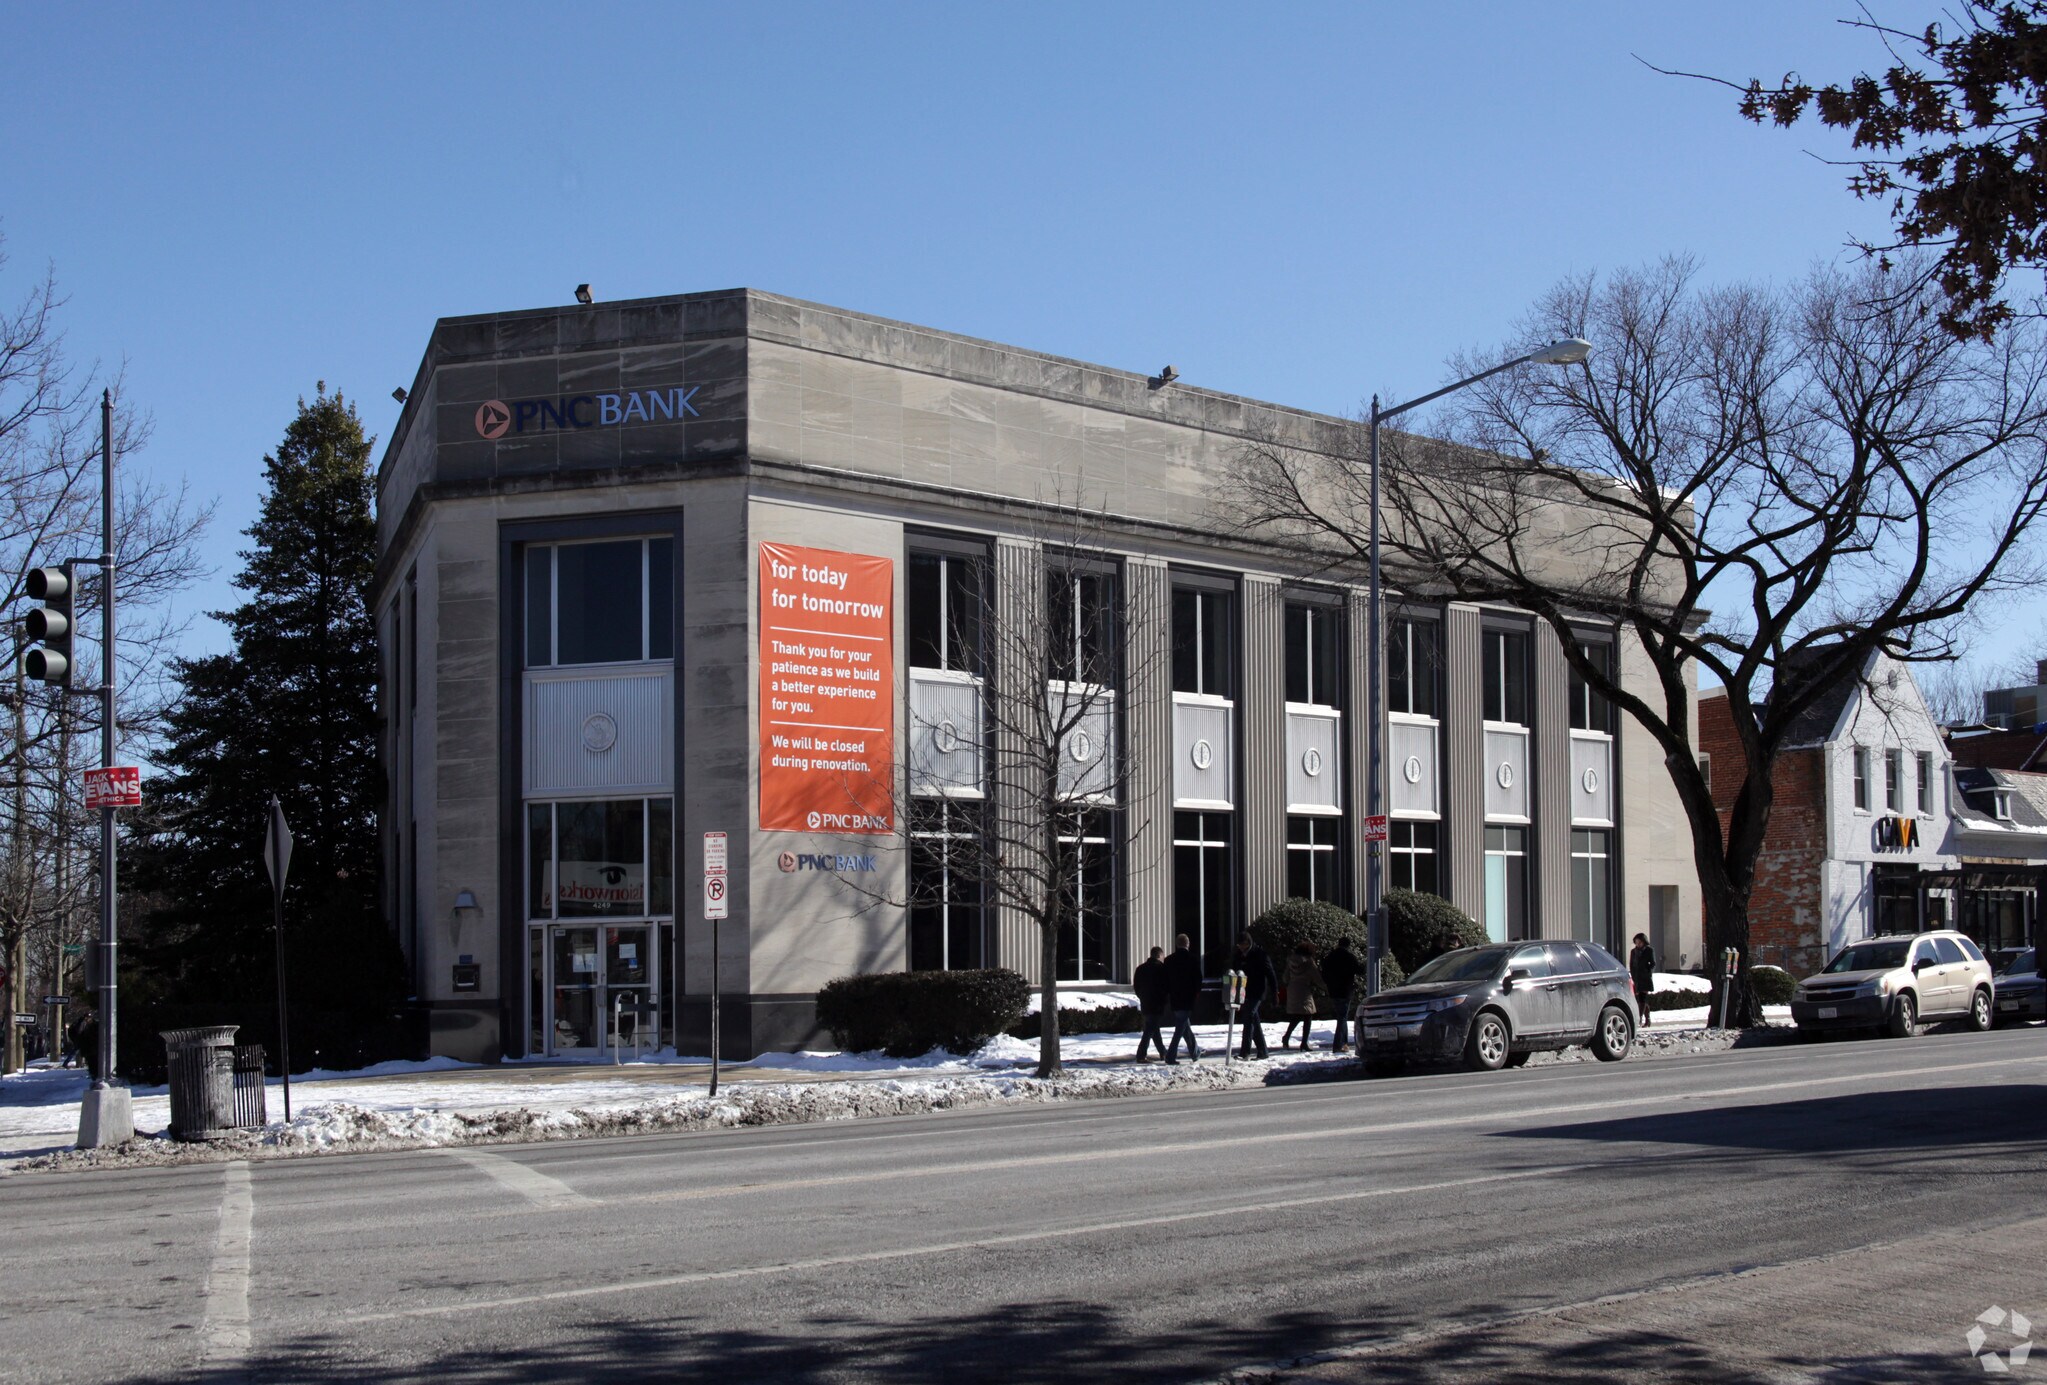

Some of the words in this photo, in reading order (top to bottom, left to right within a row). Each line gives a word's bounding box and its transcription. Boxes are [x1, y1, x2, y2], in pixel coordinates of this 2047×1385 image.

[772, 559, 797, 579] for
[802, 564, 848, 590] today
[772, 588, 797, 608] for
[802, 593, 884, 619] tomorrow
[771, 640, 806, 656] Thank
[808, 647, 828, 659] you
[830, 647, 845, 659] for
[848, 651, 872, 663] your
[772, 661, 818, 676] patience
[820, 666, 833, 677] as
[835, 669, 851, 679] we
[853, 667, 880, 681] build
[771, 681, 779, 691] a
[781, 680, 815, 694] better
[817, 685, 876, 699] experience
[772, 698, 788, 710] for
[790, 702, 814, 714] you.
[772, 734, 789, 748] We
[791, 736, 812, 750] will
[814, 738, 828, 751] be
[830, 740, 865, 753] closed
[772, 754, 808, 771] during
[811, 758, 871, 772] renovation.
[86, 772, 109, 784] JACK
[85, 780, 139, 798] EVANS
[1878, 816, 1920, 848] CAVA
